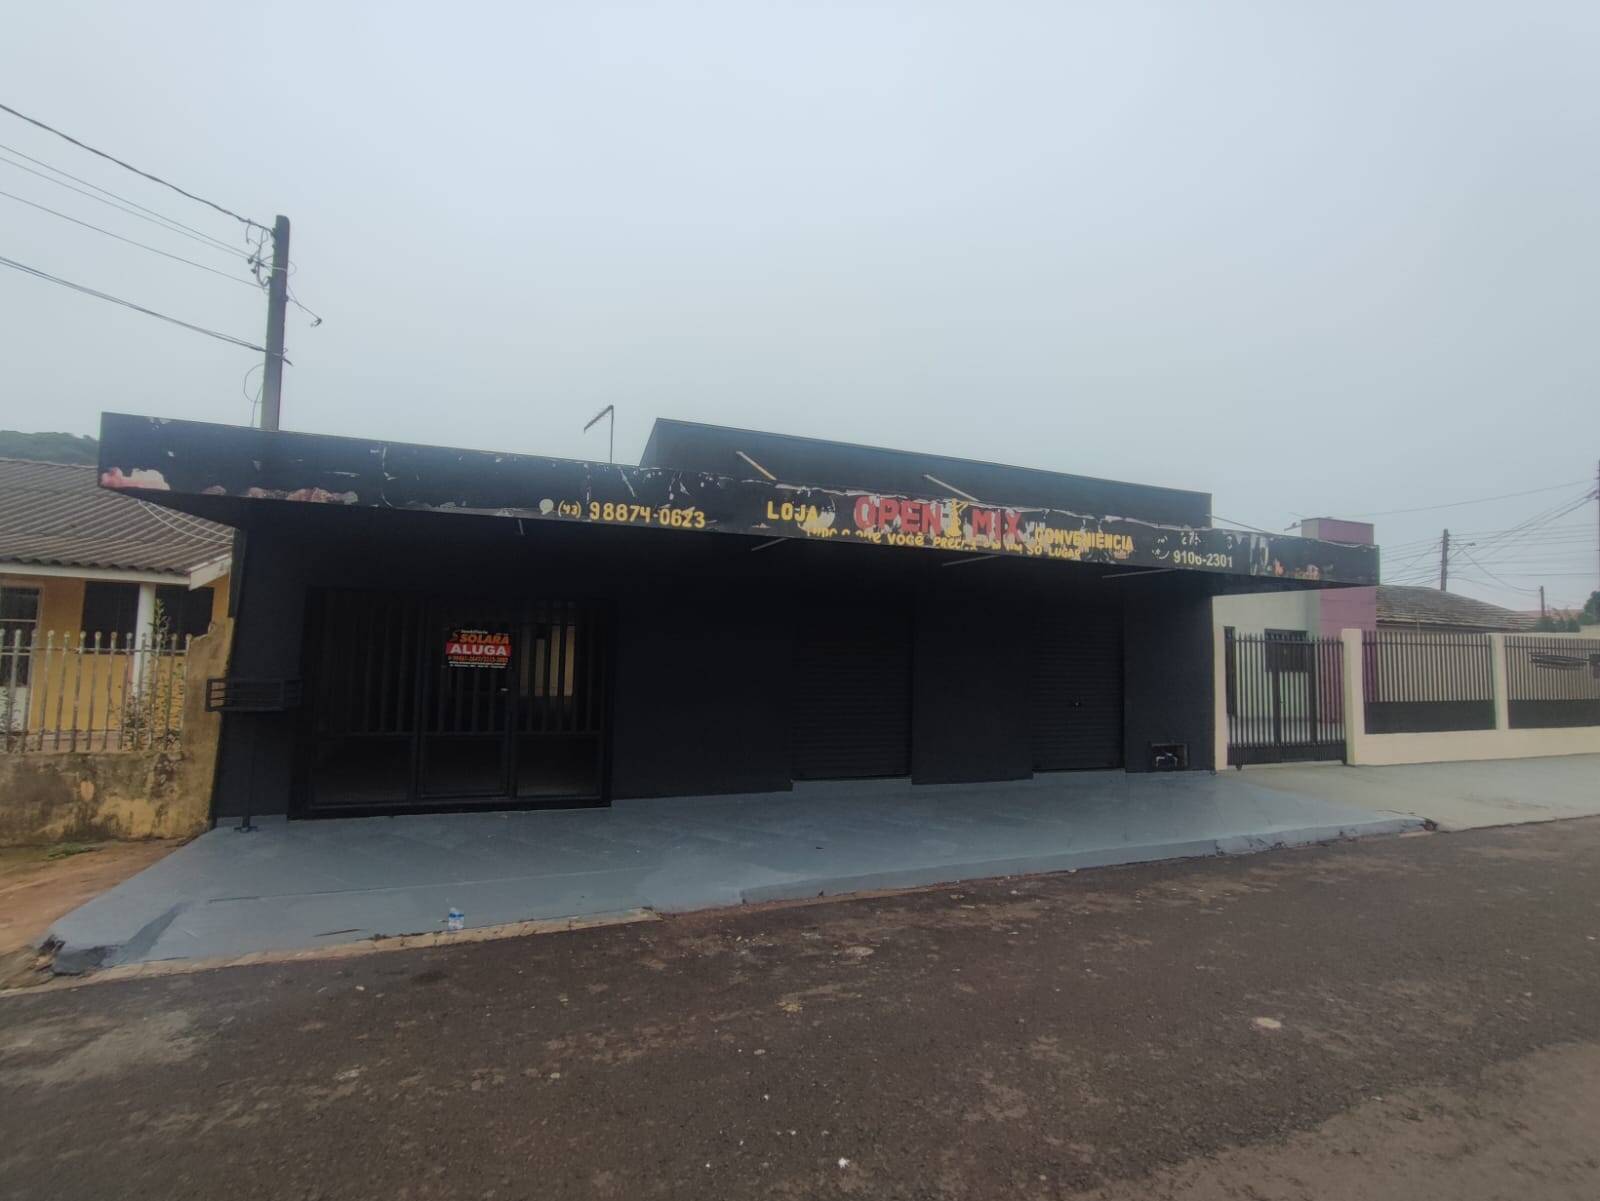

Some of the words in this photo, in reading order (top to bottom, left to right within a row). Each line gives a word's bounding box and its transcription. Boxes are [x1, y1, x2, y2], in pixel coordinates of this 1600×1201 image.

[589, 501, 706, 529] 98874-0623
[767, 501, 818, 522] LOJA
[854, 495, 942, 534] OPEN
[971, 508, 1024, 541] MIX
[1173, 549, 1233, 568] 9106-2301
[450, 643, 507, 655] ALUGA
